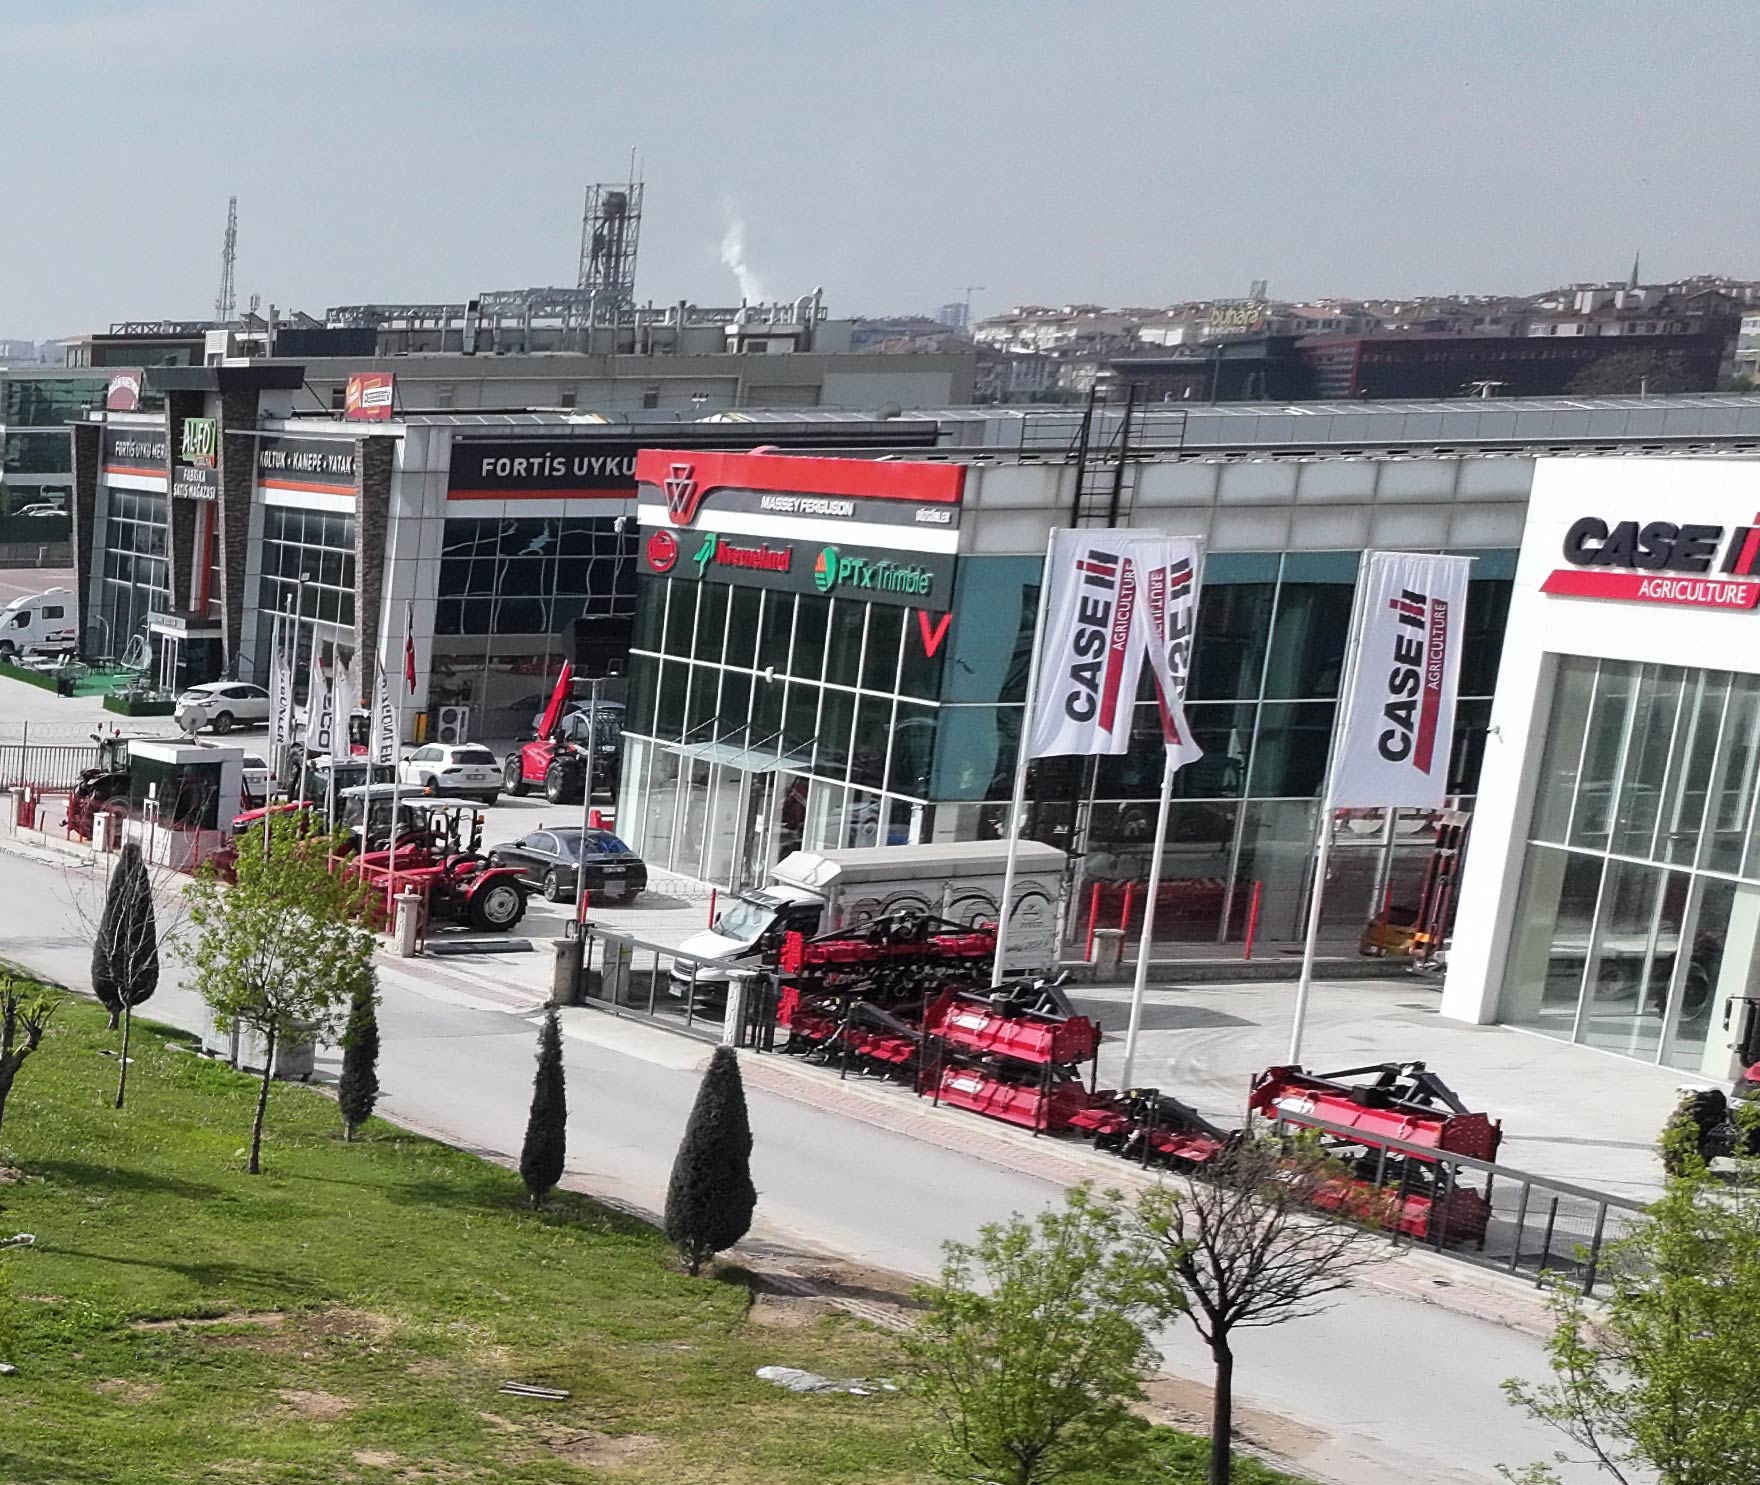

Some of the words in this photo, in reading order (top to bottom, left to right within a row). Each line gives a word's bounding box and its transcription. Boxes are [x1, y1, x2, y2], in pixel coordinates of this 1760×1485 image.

[260, 450, 287, 469] KOLTUK
[292, 452, 323, 472] KANEPE
[328, 454, 353, 474] YATAK
[481, 452, 566, 477] FORTİS
[573, 456, 636, 476] UYKU
[761, 496, 800, 511] MASSEY
[799, 498, 854, 516] FERGUSON
[1562, 516, 1724, 572] CASE
[838, 558, 872, 587] PTx
[876, 561, 930, 594] Trimble
[1637, 578, 1747, 605] AGRICULTURE
[1111, 562, 1135, 651] AGRICULTURE
[1065, 595, 1111, 723] CASE
[1427, 602, 1448, 690] AGRICULTURE
[1378, 634, 1424, 762] CASE
